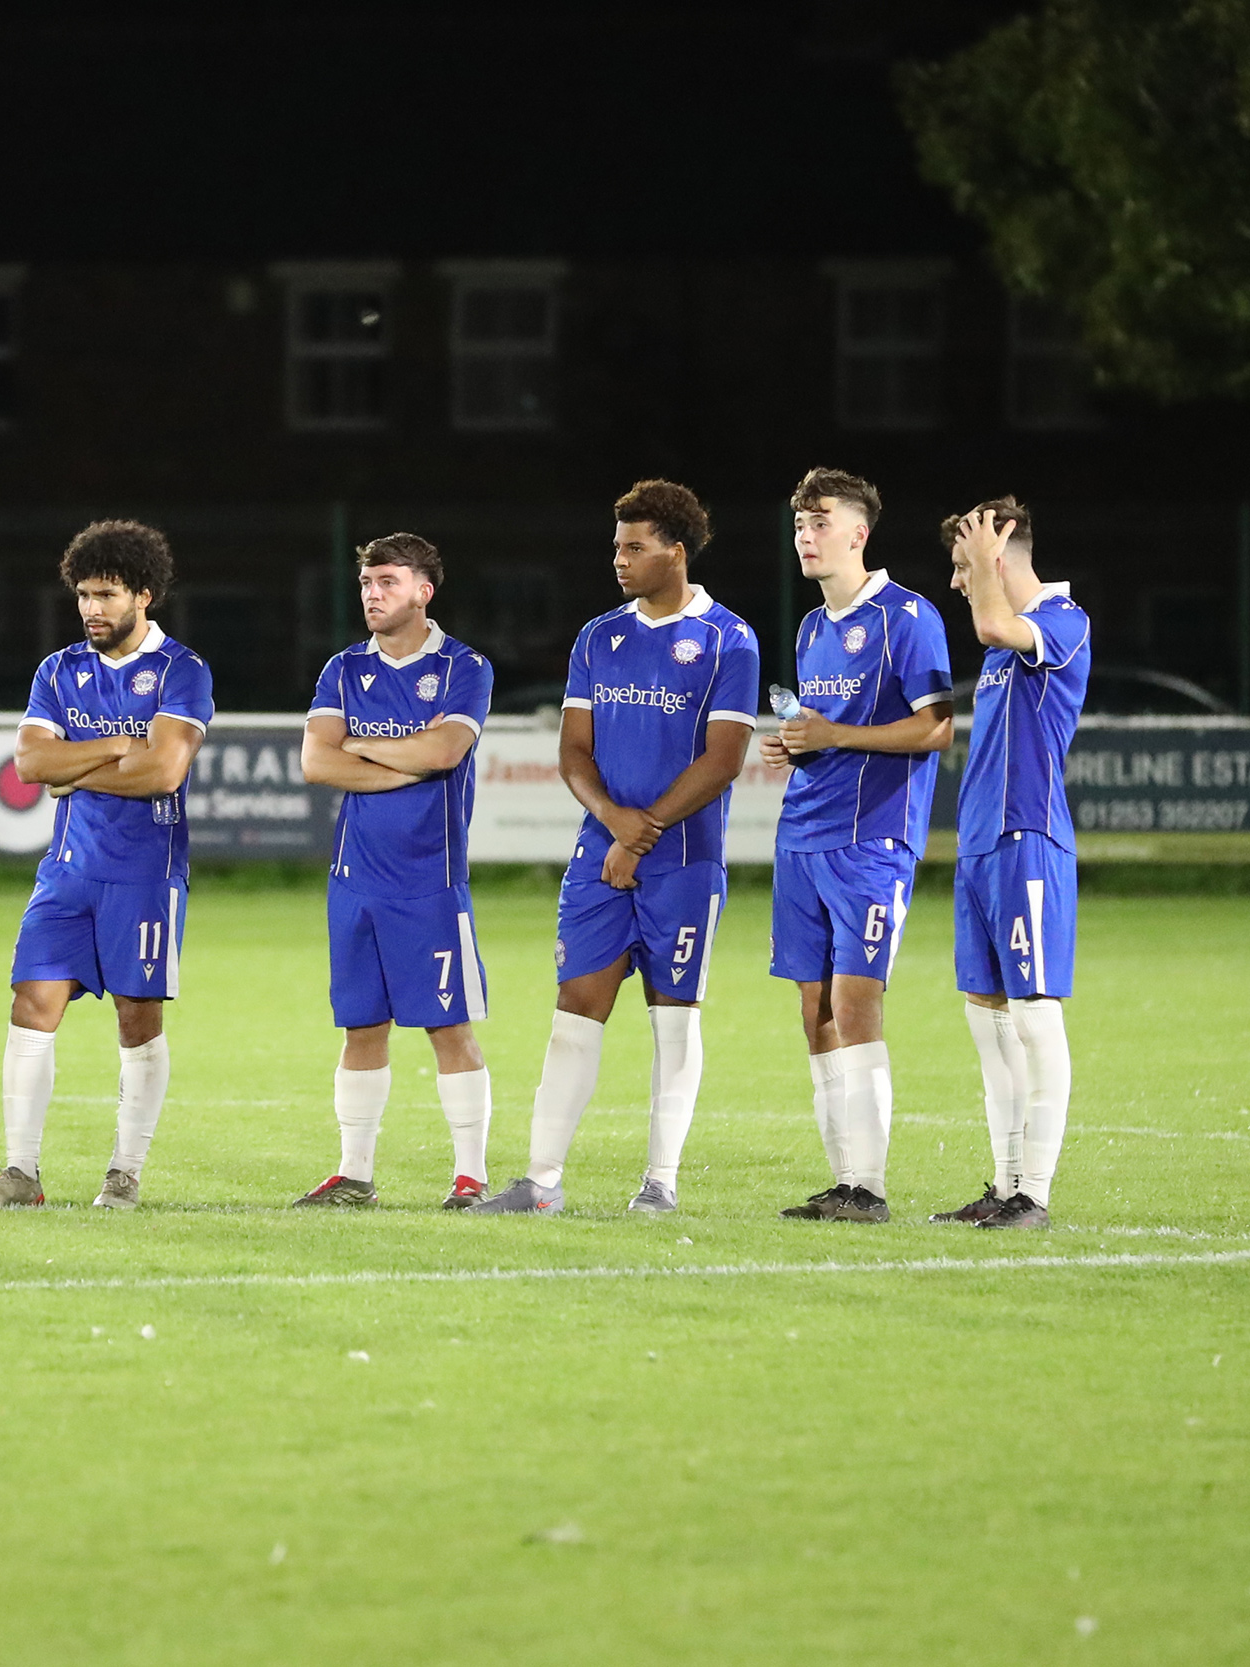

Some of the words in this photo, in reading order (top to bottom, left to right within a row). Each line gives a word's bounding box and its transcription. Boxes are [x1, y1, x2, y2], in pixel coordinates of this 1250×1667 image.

[138, 922, 161, 959] 11
[864, 904, 887, 942] 6
[1009, 916, 1031, 957] 4
[673, 926, 697, 963] 5
[433, 950, 452, 989] 7
